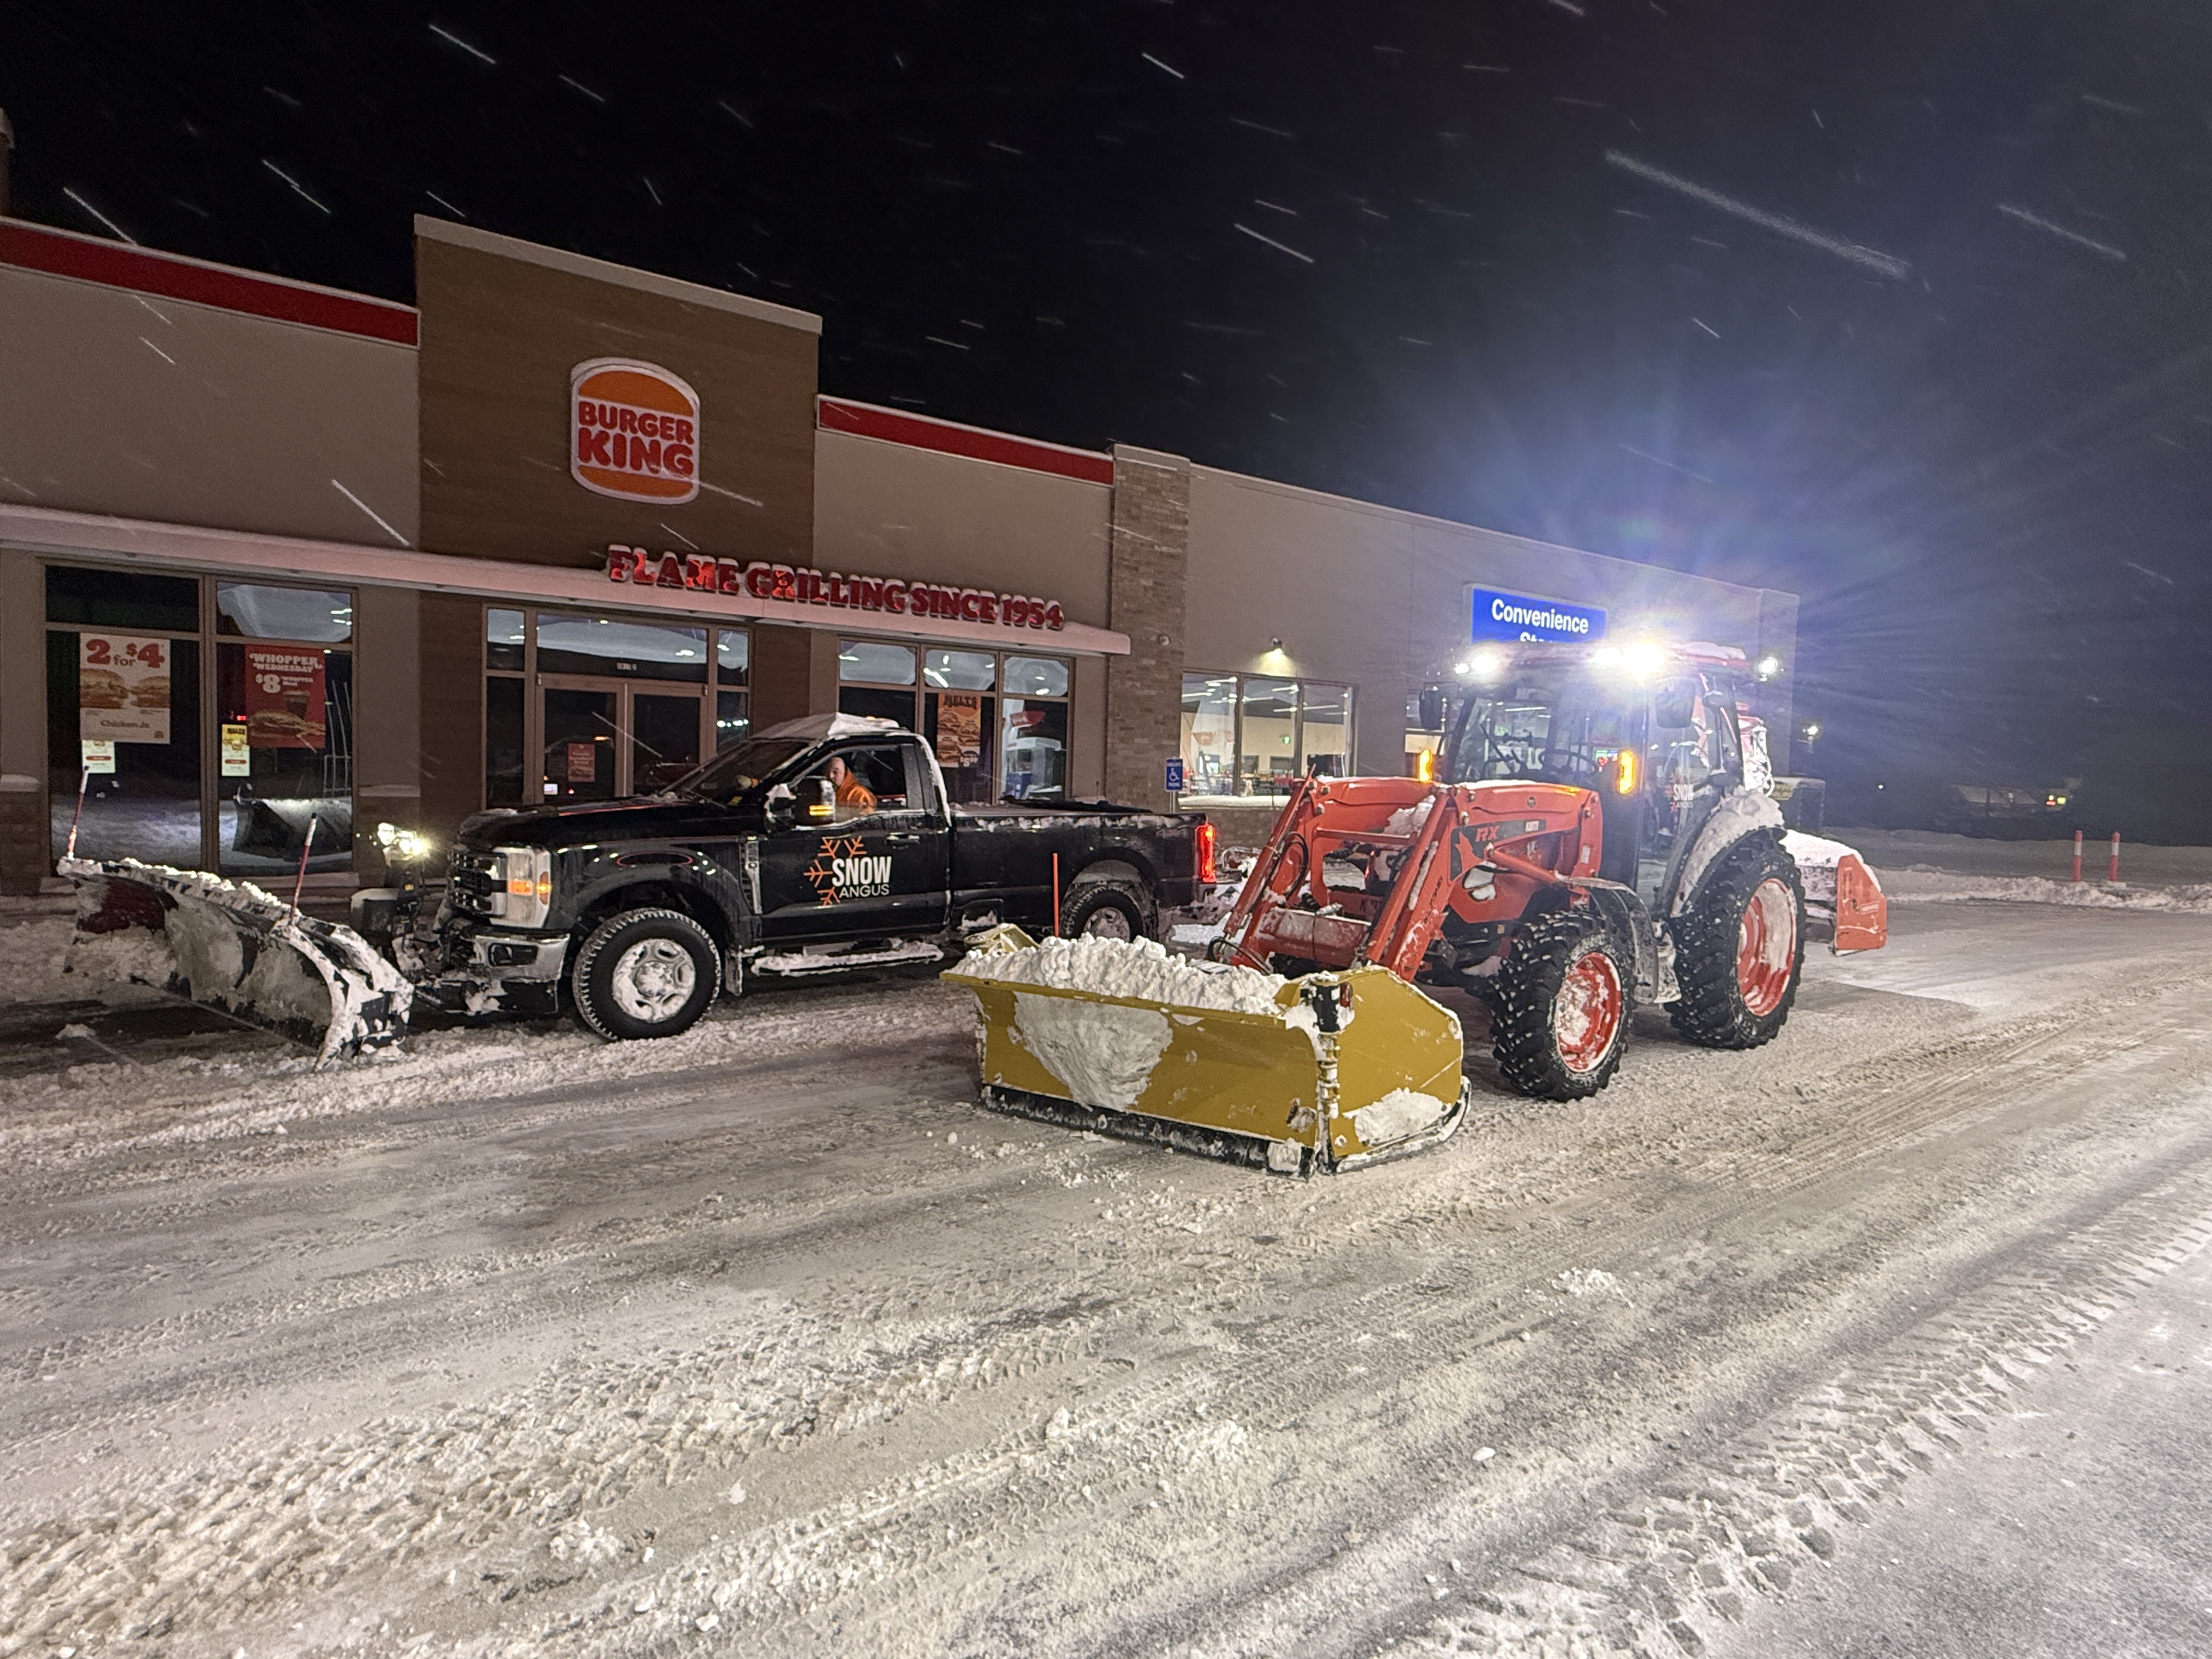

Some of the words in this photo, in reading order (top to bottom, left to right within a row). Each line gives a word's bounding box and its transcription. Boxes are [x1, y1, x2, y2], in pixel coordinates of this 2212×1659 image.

[578, 401, 694, 445] BURGER
[578, 427, 693, 477] KING
[609, 545, 739, 595] FLAME
[746, 562, 906, 612] GRILLING
[910, 582, 997, 624] SINCE
[1000, 594, 1064, 630] 1954
[1492, 599, 1589, 634] Convenience
[86, 639, 111, 665] 2
[114, 654, 136, 667] for
[126, 642, 165, 668] $4
[249, 653, 323, 669] WHOPPER
[943, 694, 978, 710] MELTS
[1673, 783, 1694, 801] SNOW
[1475, 825, 1499, 843] RX
[832, 856, 892, 887] SNOW
[839, 884, 890, 899] ANGUS
